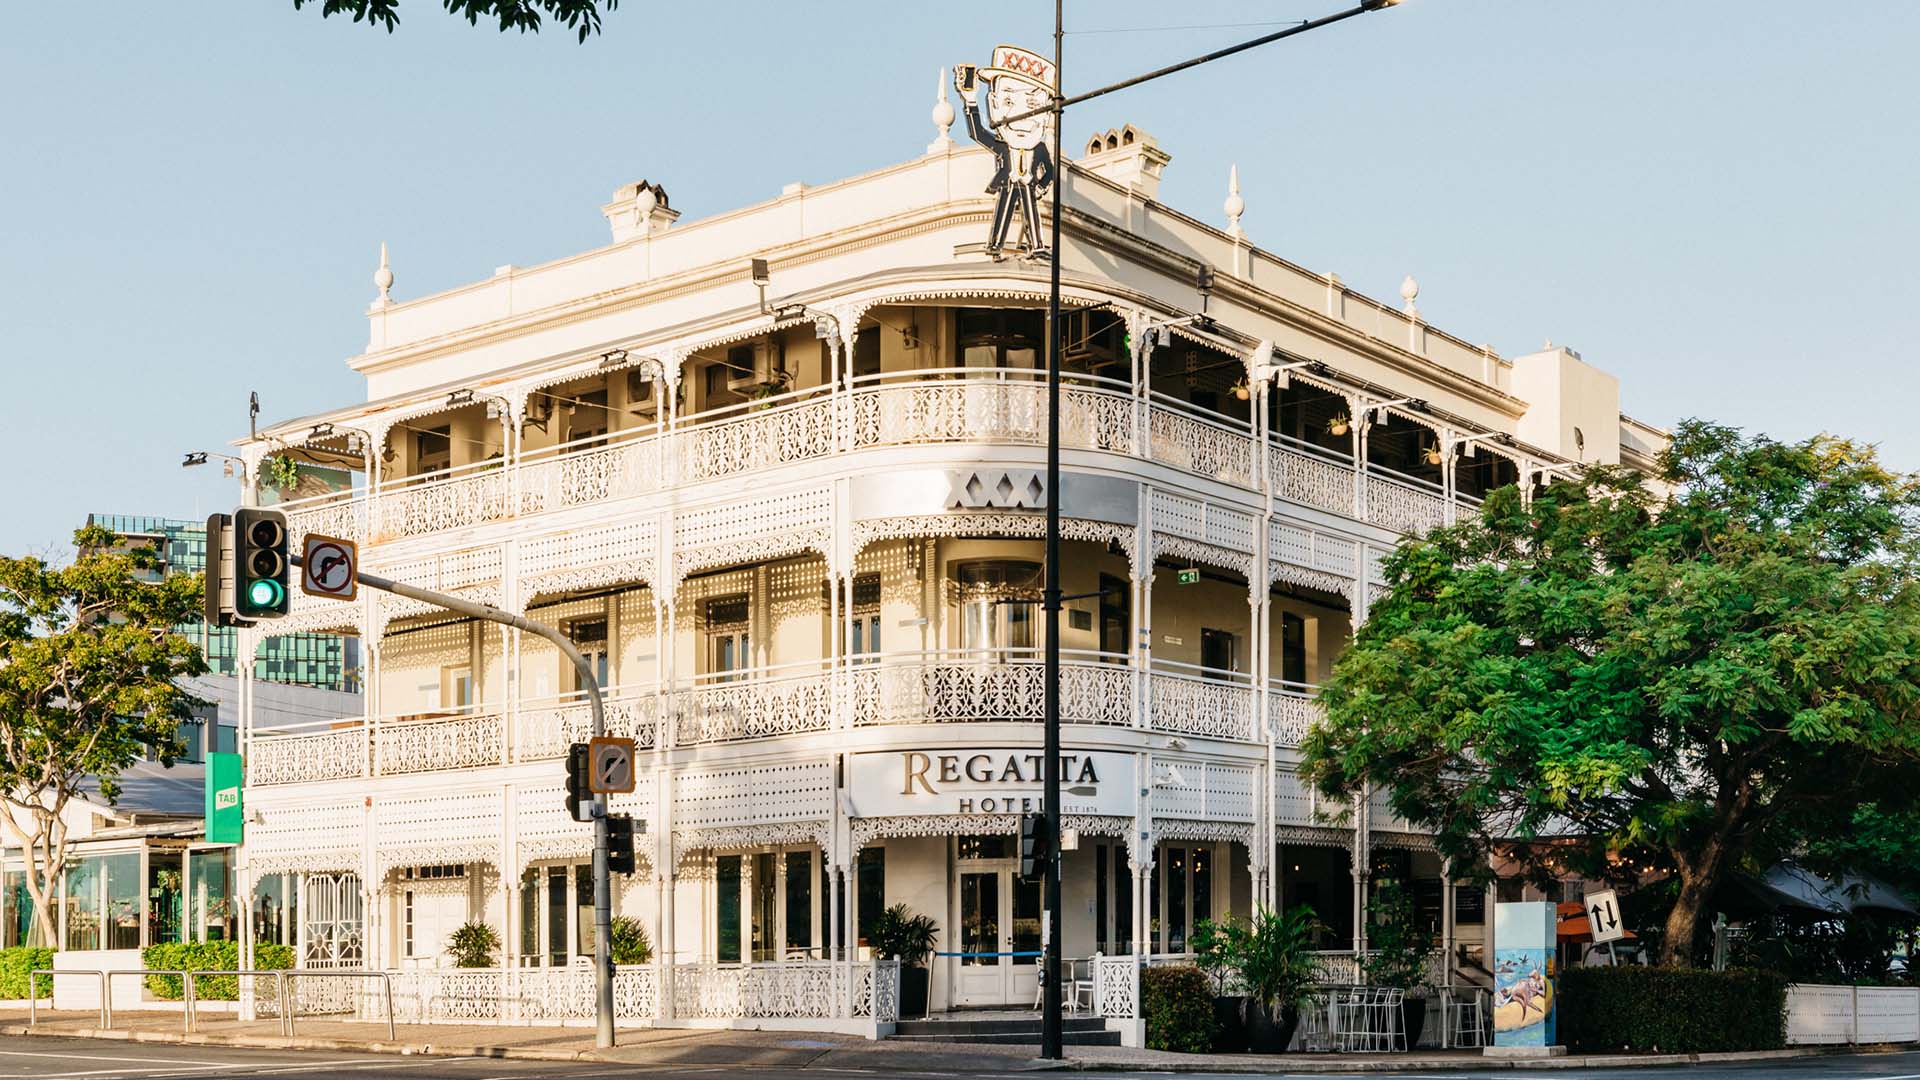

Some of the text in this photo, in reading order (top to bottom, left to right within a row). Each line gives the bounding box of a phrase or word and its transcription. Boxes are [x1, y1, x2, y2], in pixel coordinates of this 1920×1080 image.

[1001, 51, 1048, 81] XXXX
[900, 752, 1100, 795] REGATTA
[218, 794, 236, 803] TAB
